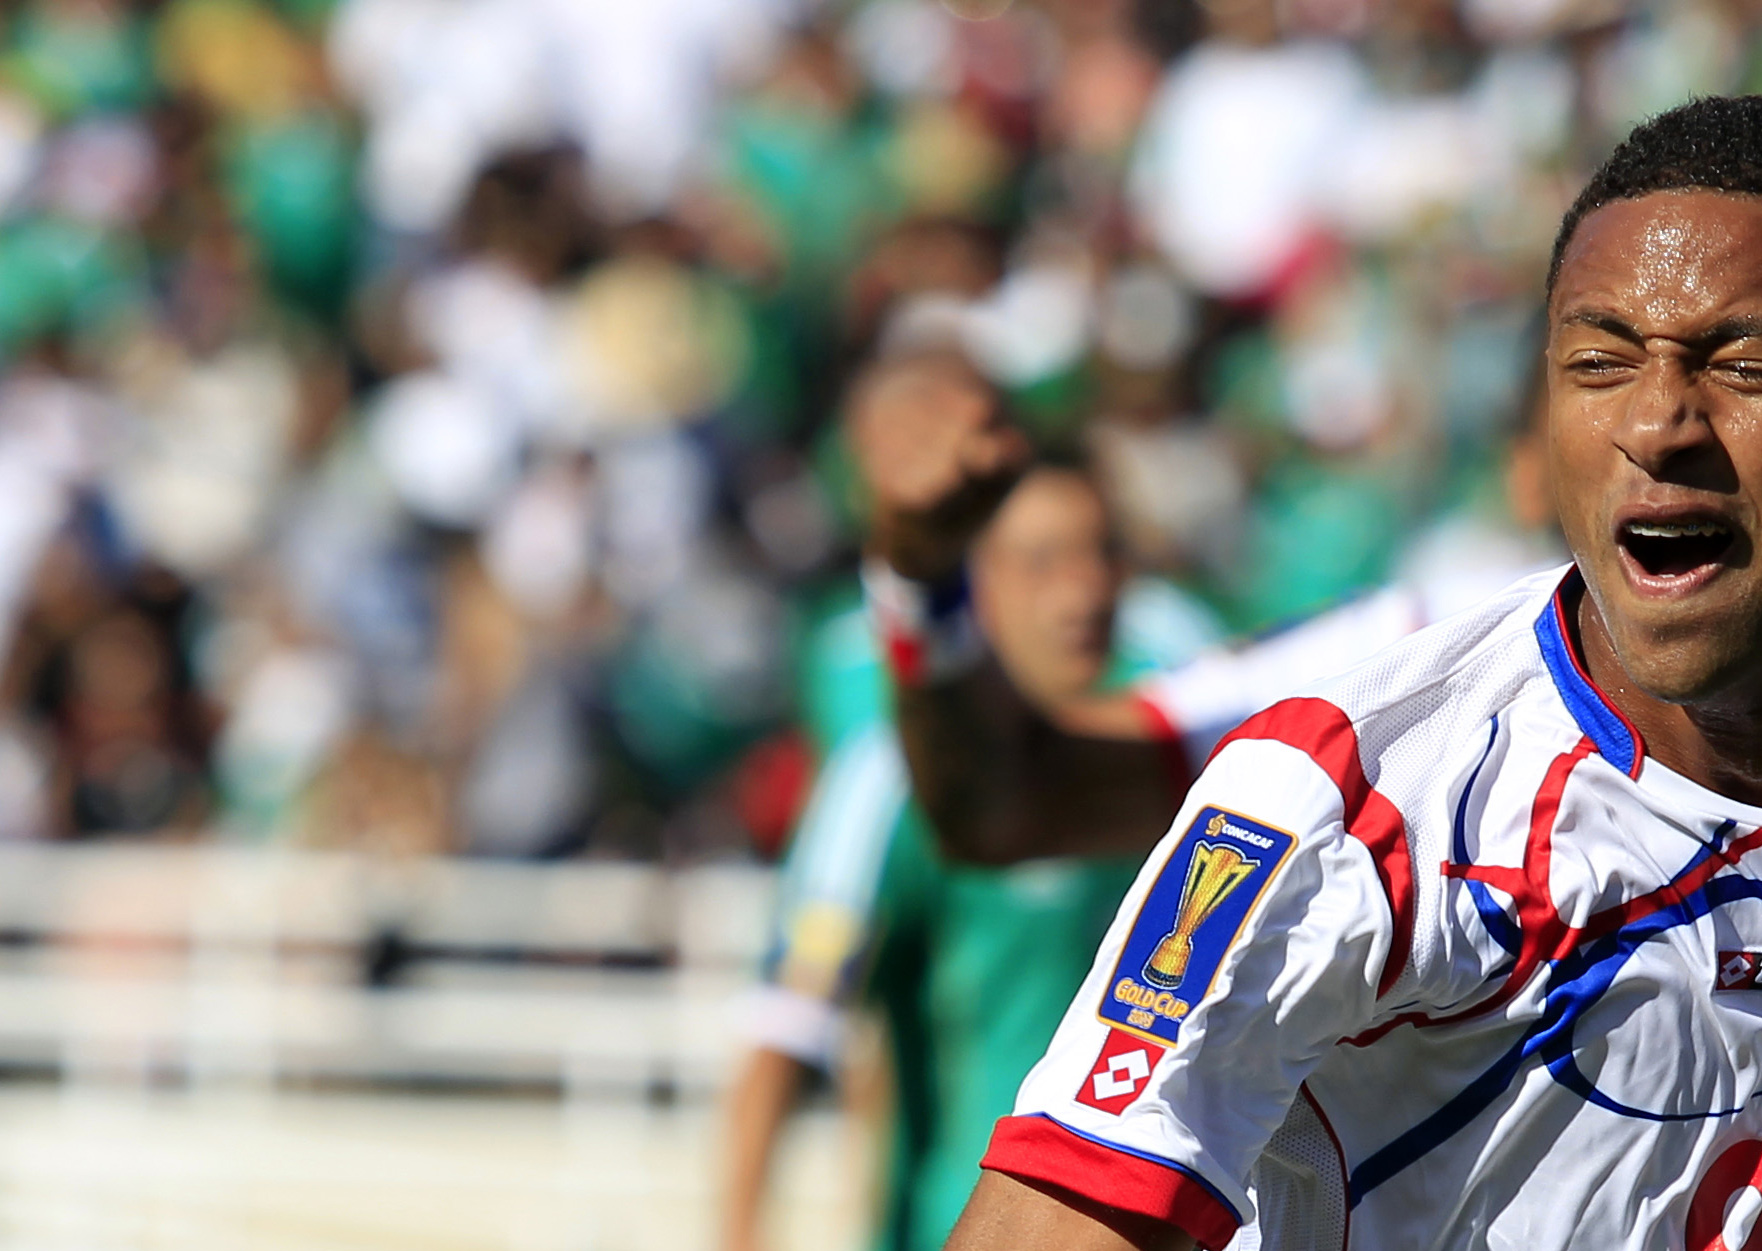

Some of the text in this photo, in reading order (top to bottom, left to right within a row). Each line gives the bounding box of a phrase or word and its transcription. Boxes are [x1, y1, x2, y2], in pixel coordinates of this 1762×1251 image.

[1221, 823, 1275, 850] CONCACAF
[1114, 977, 1155, 1010] GOLD
[1153, 991, 1190, 1019] CUP
